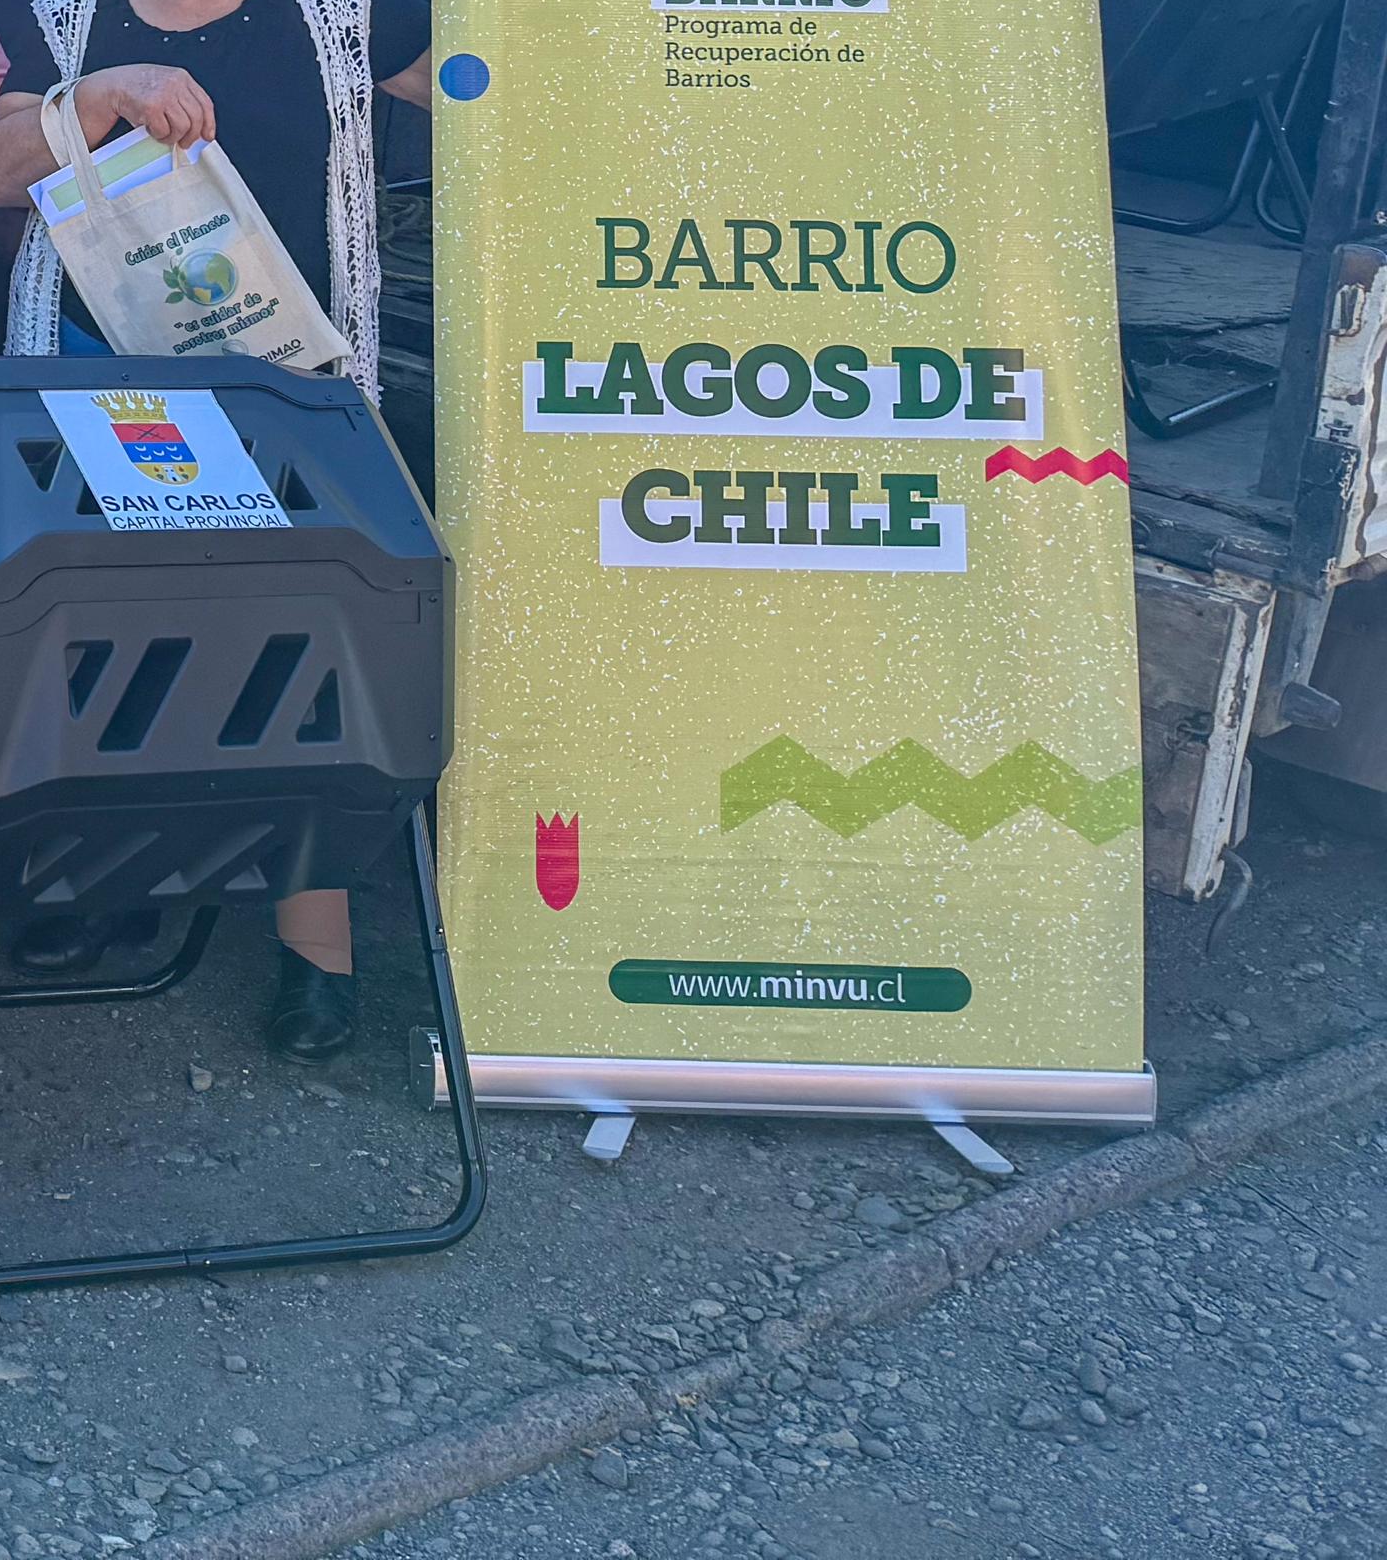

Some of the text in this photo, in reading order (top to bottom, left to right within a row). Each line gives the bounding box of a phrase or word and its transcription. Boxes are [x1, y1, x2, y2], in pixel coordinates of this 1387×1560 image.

[665, 15, 817, 38] Programa de
[665, 42, 865, 66] Recuperación de
[665, 69, 751, 88] Barrios
[124, 213, 230, 266] Cuidar el Planeta
[595, 217, 956, 294] BARRIO
[201, 301, 241, 326] cuidar
[244, 292, 262, 308] de
[173, 328, 226, 355] nosotros
[536, 341, 1026, 421] LAGOS DE
[101, 493, 276, 512] SAN CARLOS
[621, 468, 941, 547] CHILE
[113, 513, 287, 530] CAPITAL PROVINCIAL
[669, 970, 906, 1003] www.minvu.cl
